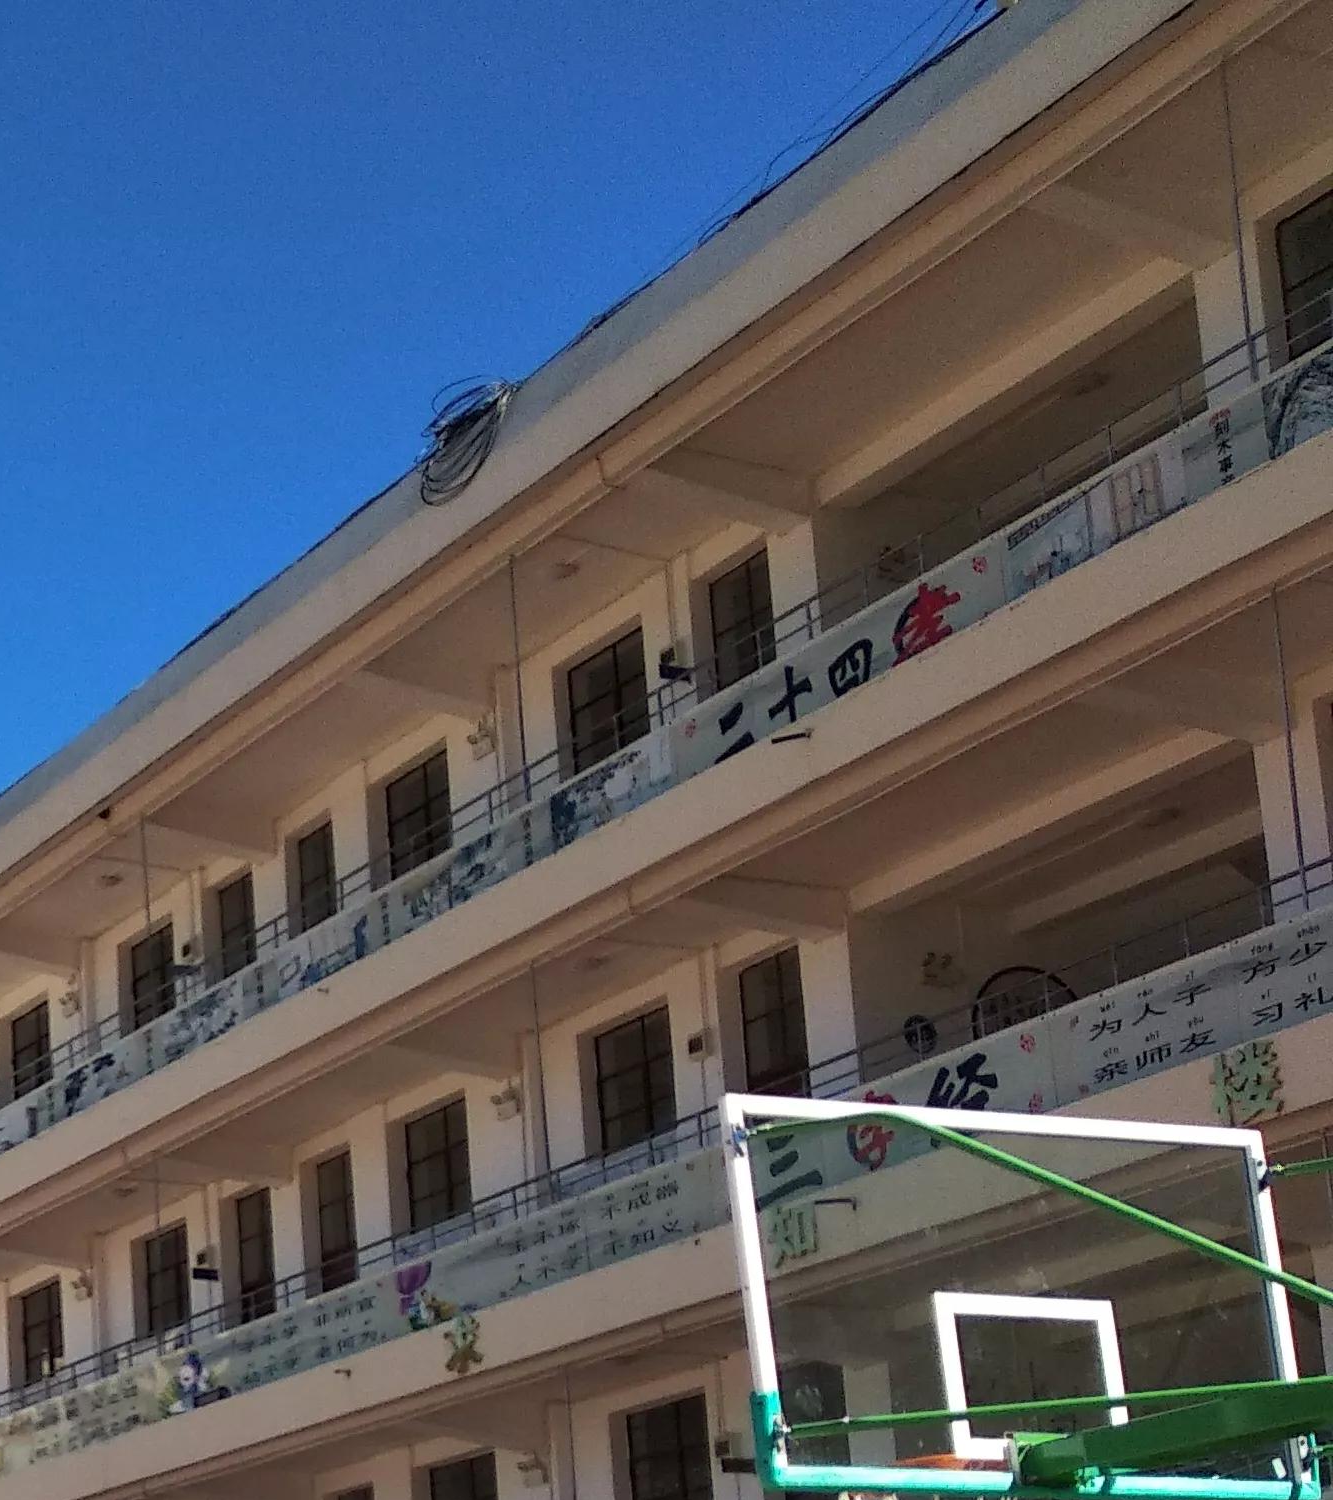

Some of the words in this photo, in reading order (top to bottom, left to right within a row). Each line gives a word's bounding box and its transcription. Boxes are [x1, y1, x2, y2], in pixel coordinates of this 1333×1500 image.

[1090, 984, 1211, 1041] 为人子
[1093, 1029, 1216, 1083] 亲师友
